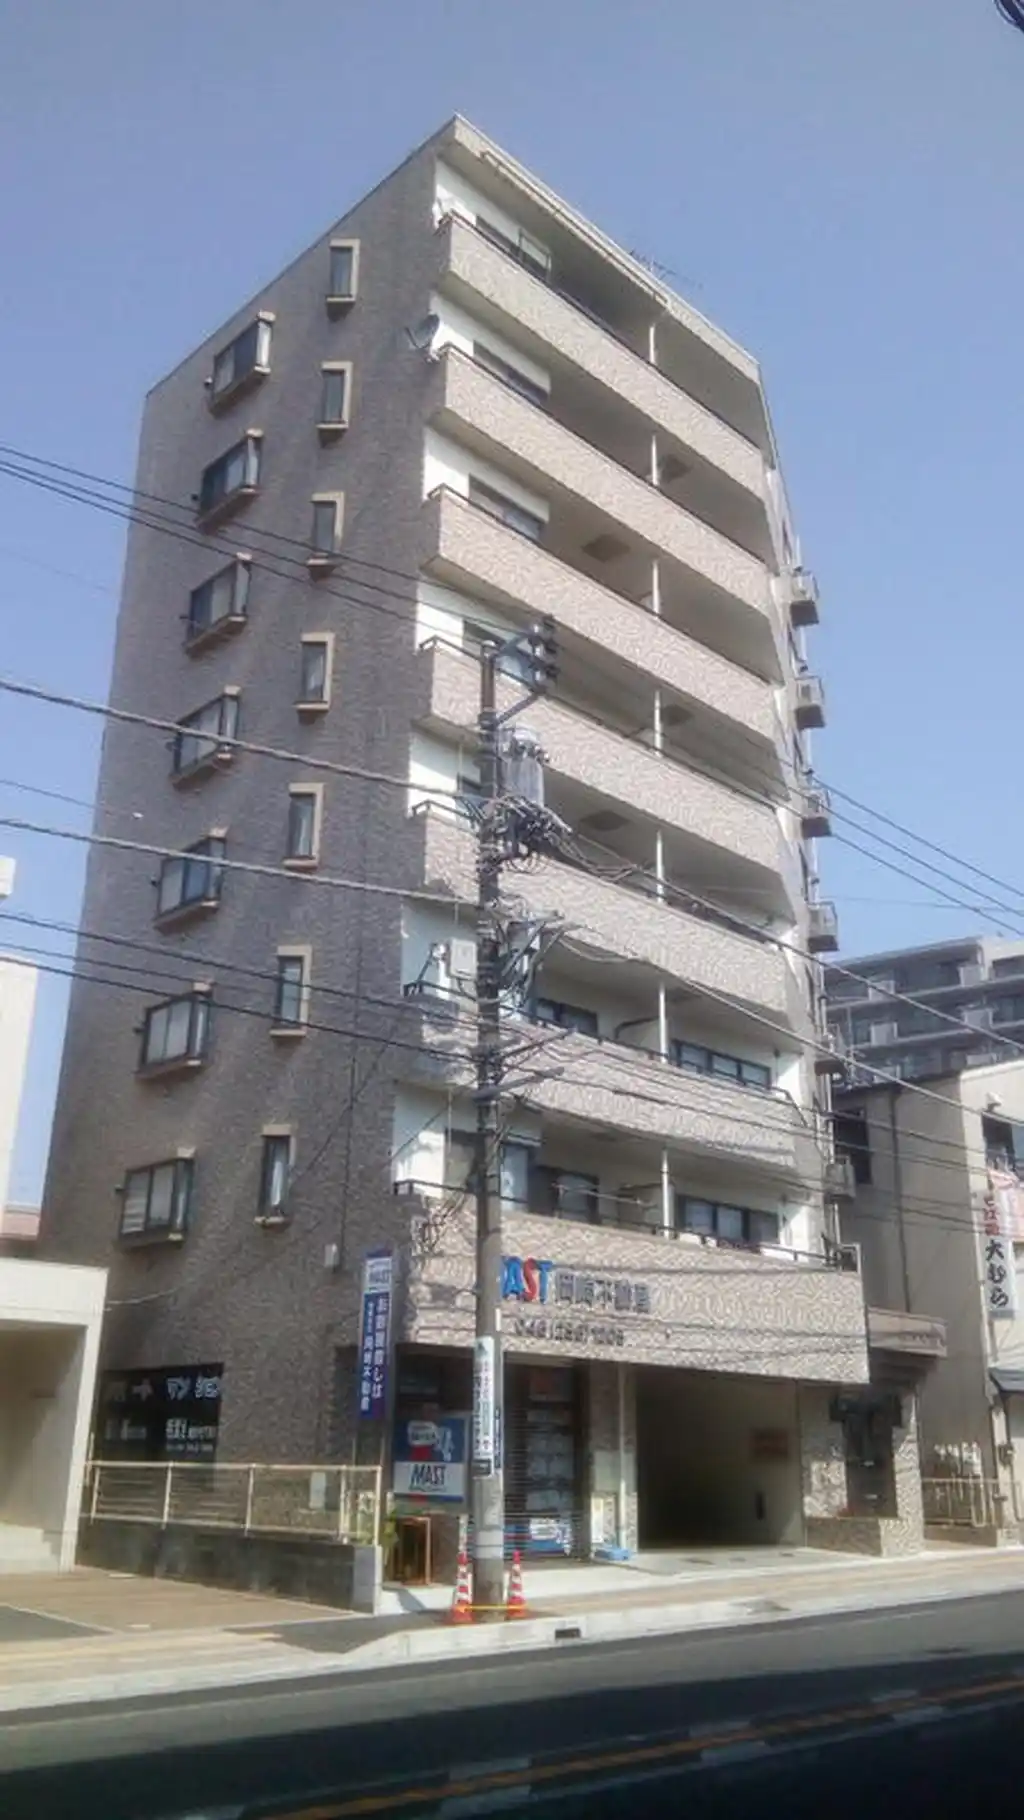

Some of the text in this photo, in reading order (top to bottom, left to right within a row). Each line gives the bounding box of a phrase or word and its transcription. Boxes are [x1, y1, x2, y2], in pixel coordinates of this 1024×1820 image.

[501, 1255, 553, 1304] AST
[985, 1239, 1009, 1308] 大むら
[410, 1463, 446, 1485] MAST
